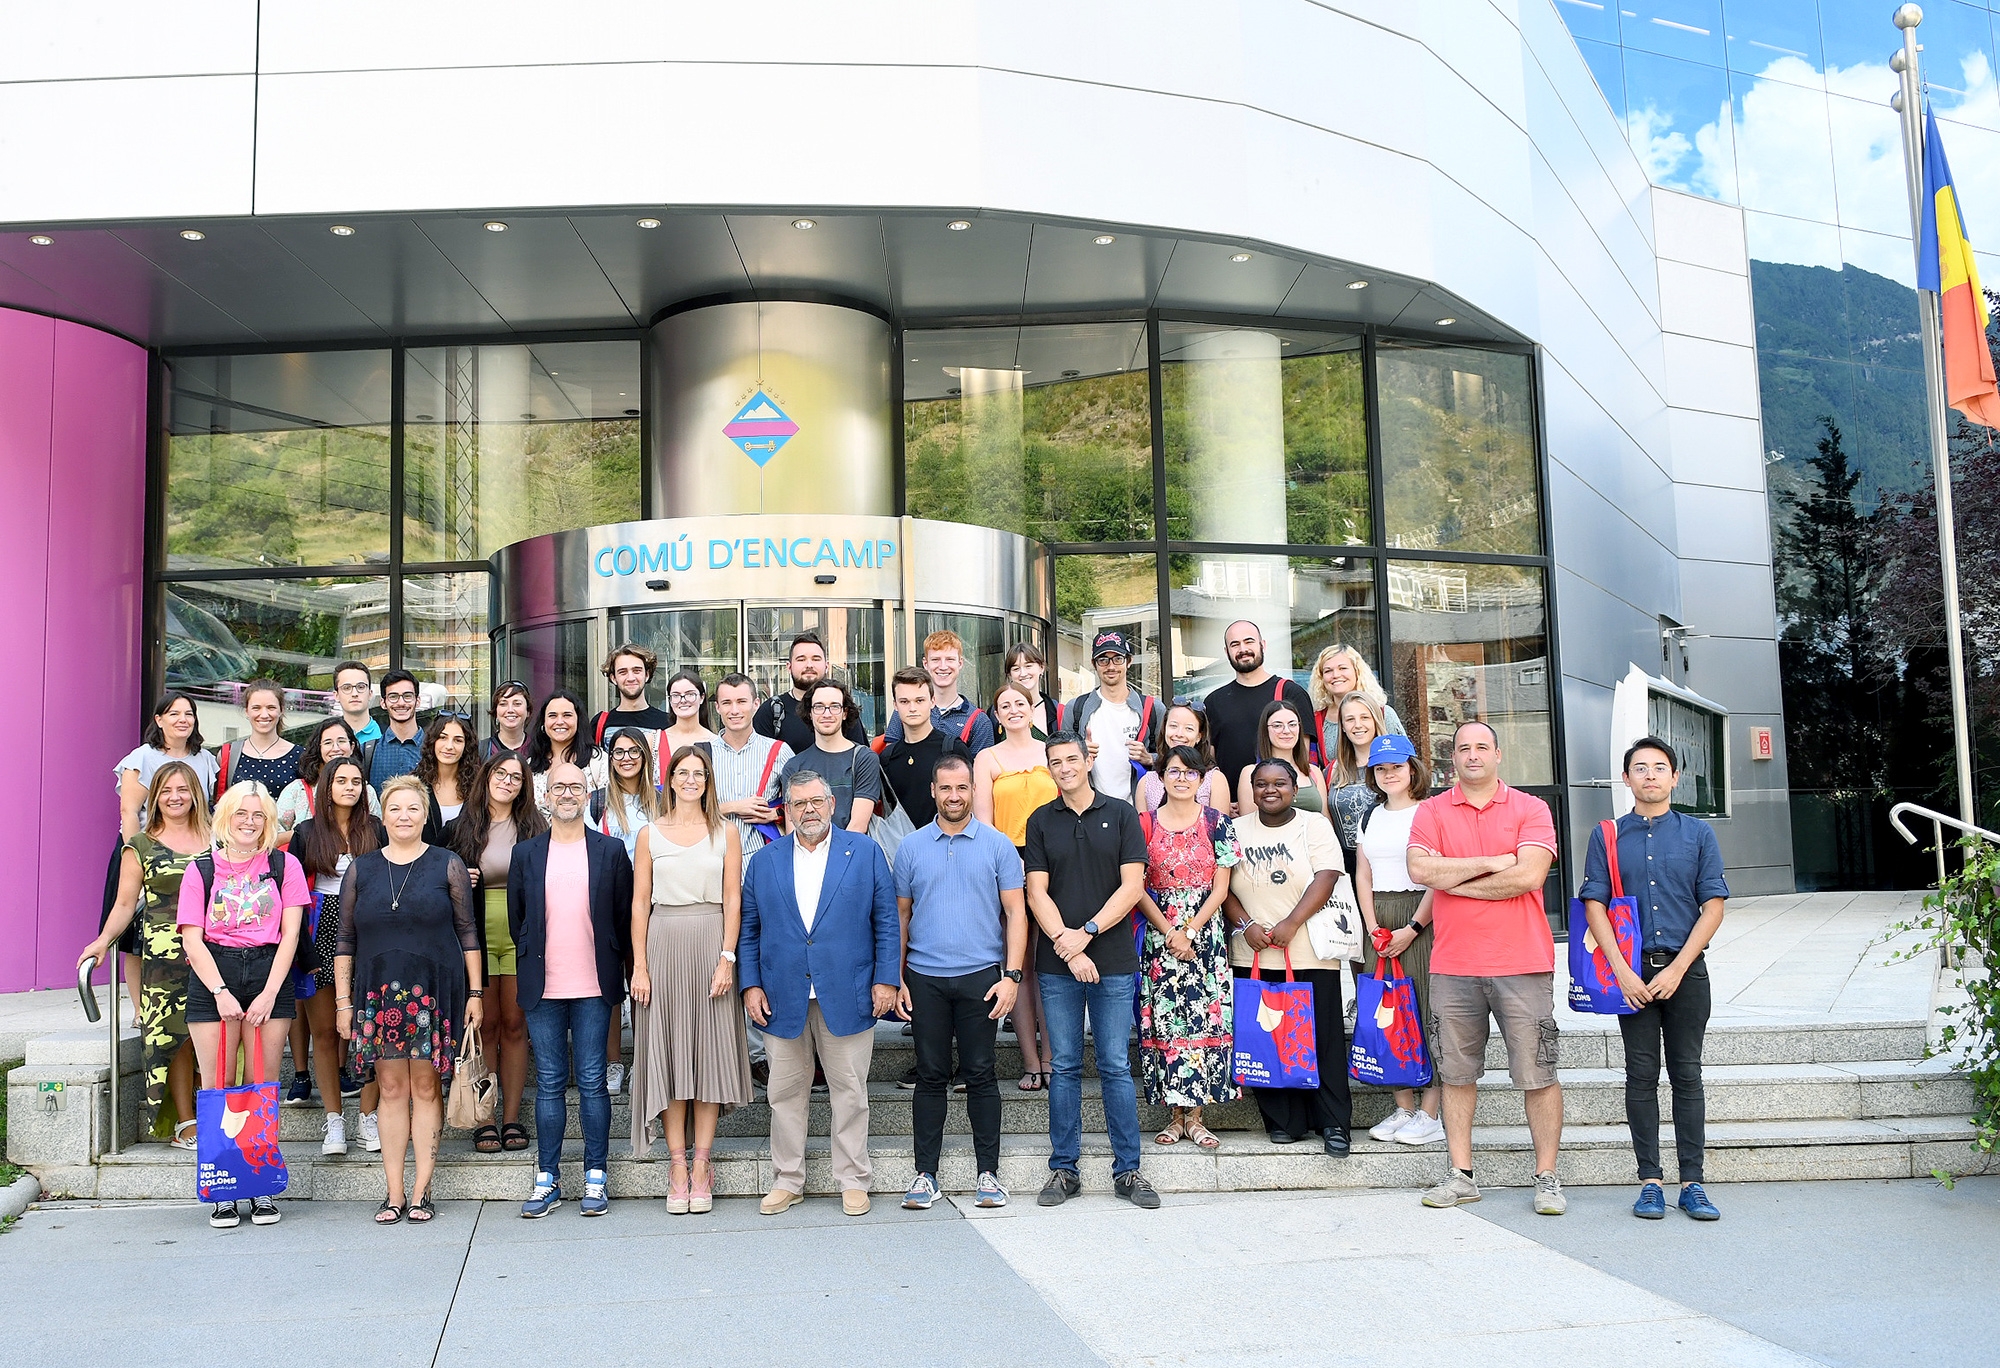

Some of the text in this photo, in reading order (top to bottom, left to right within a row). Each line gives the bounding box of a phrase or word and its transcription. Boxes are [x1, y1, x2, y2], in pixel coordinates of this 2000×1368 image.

[594, 533, 897, 577] COMÚ D'ENCAMP
[1235, 1052, 1251, 1060] FER
[1235, 1059, 1264, 1069] VOLAR
[1235, 1067, 1271, 1078] COLOMS
[200, 1163, 215, 1171] FER
[199, 1177, 237, 1187] COLOMS
